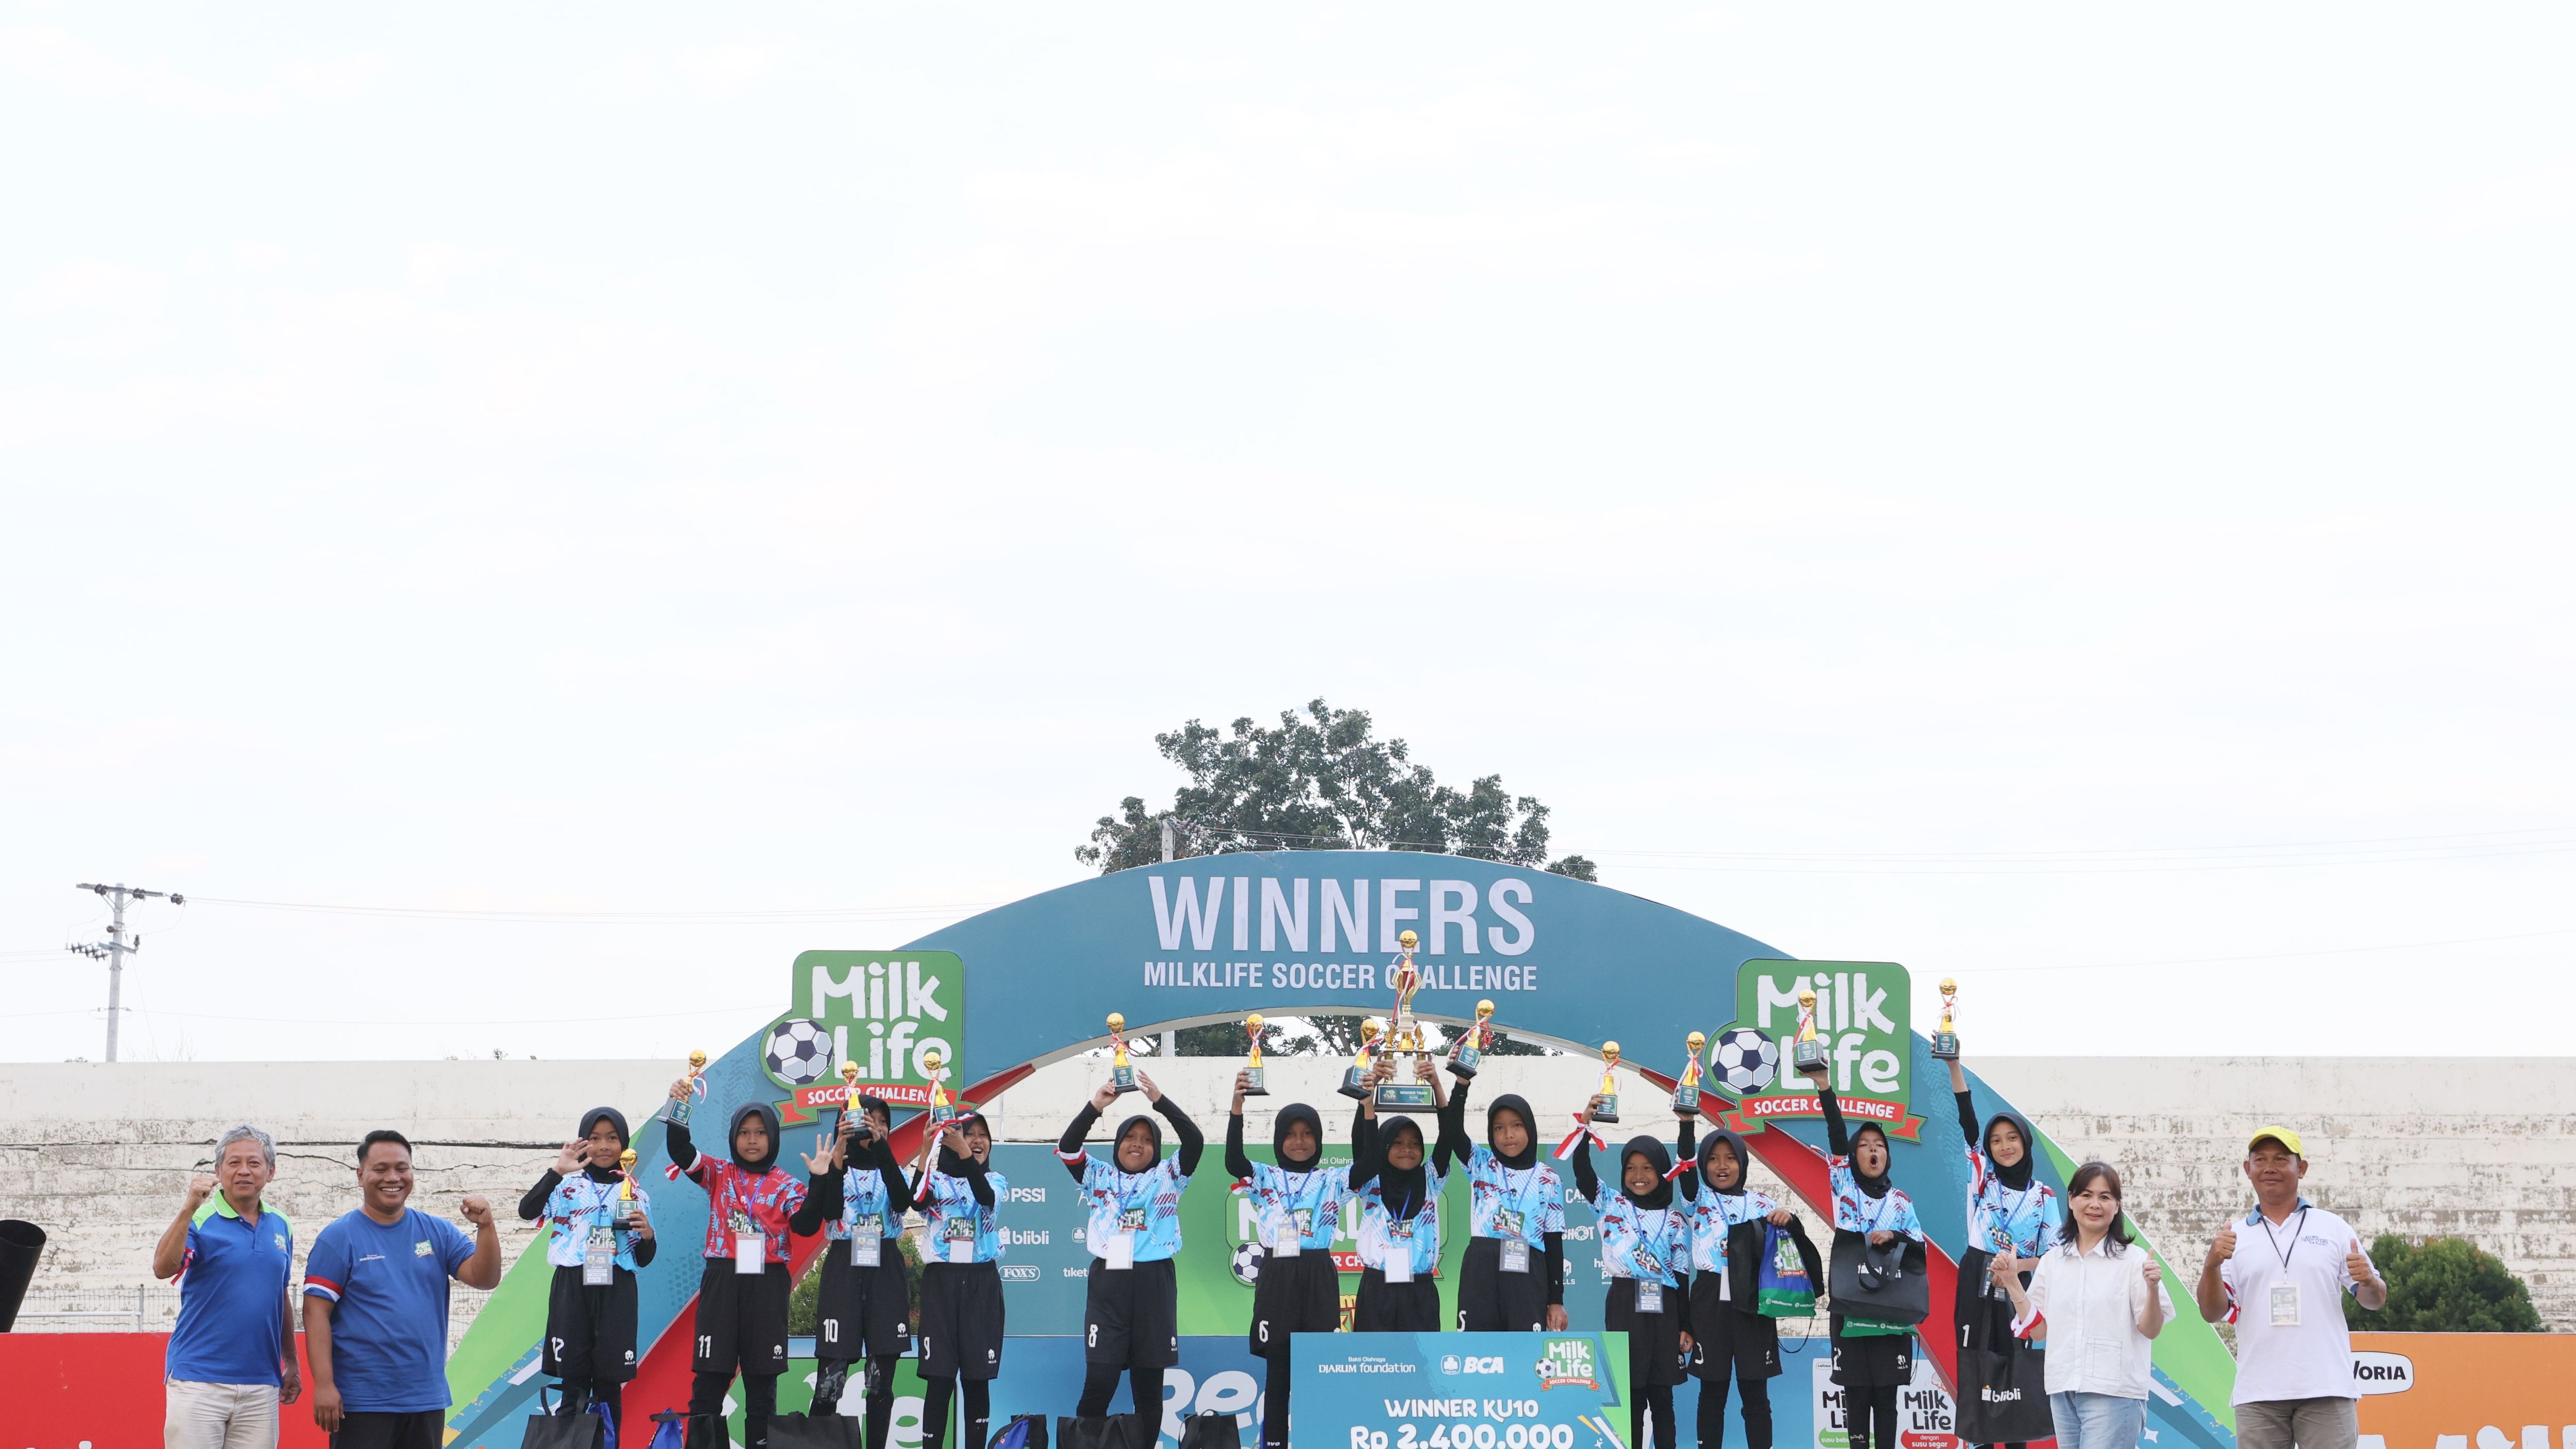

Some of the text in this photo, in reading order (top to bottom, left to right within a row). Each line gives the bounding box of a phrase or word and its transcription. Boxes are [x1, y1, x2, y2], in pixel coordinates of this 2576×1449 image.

[1148, 876, 1535, 956] WINNERS
[1144, 962, 1537, 991] MILKLIFE SOCCER CALLENGE
[812, 962, 948, 1022] Milk
[1757, 972, 1895, 1035] Milk
[833, 1021, 952, 1081] Life
[866, 1087, 947, 1105] CHALLEN
[1754, 1098, 1895, 1119] SOCCER CLLENGE
[1011, 1188, 1046, 1202] PSSI
[593, 1227, 615, 1238] Milk
[1013, 1230, 1050, 1245] blibli
[1063, 1267, 1088, 1278] tiket
[823, 1319, 839, 1342] 10
[1088, 1324, 1099, 1348] 8
[1259, 1320, 1269, 1342] 6
[1962, 1324, 1970, 1348] 1
[551, 1336, 565, 1363] 12
[698, 1335, 711, 1358] 11
[924, 1336, 930, 1360] 9
[1548, 1340, 1591, 1359] Milk
[1318, 1363, 1416, 1374] DJARUM foundation
[1463, 1356, 1504, 1374] BCA
[1556, 1359, 1593, 1377] Life
[1833, 1347, 1842, 1371] 2
[2353, 1360, 2407, 1381] ORIA
[1822, 1390, 1847, 1408] Mi
[1904, 1390, 1948, 1410] Milk
[1992, 1388, 2021, 1403] blibli
[1384, 1399, 1539, 1423] WINNER KU10
[1831, 1410, 1848, 1428] Li
[1912, 1410, 1952, 1430] Life
[1350, 1423, 1575, 1449] Rp 2.400.000
